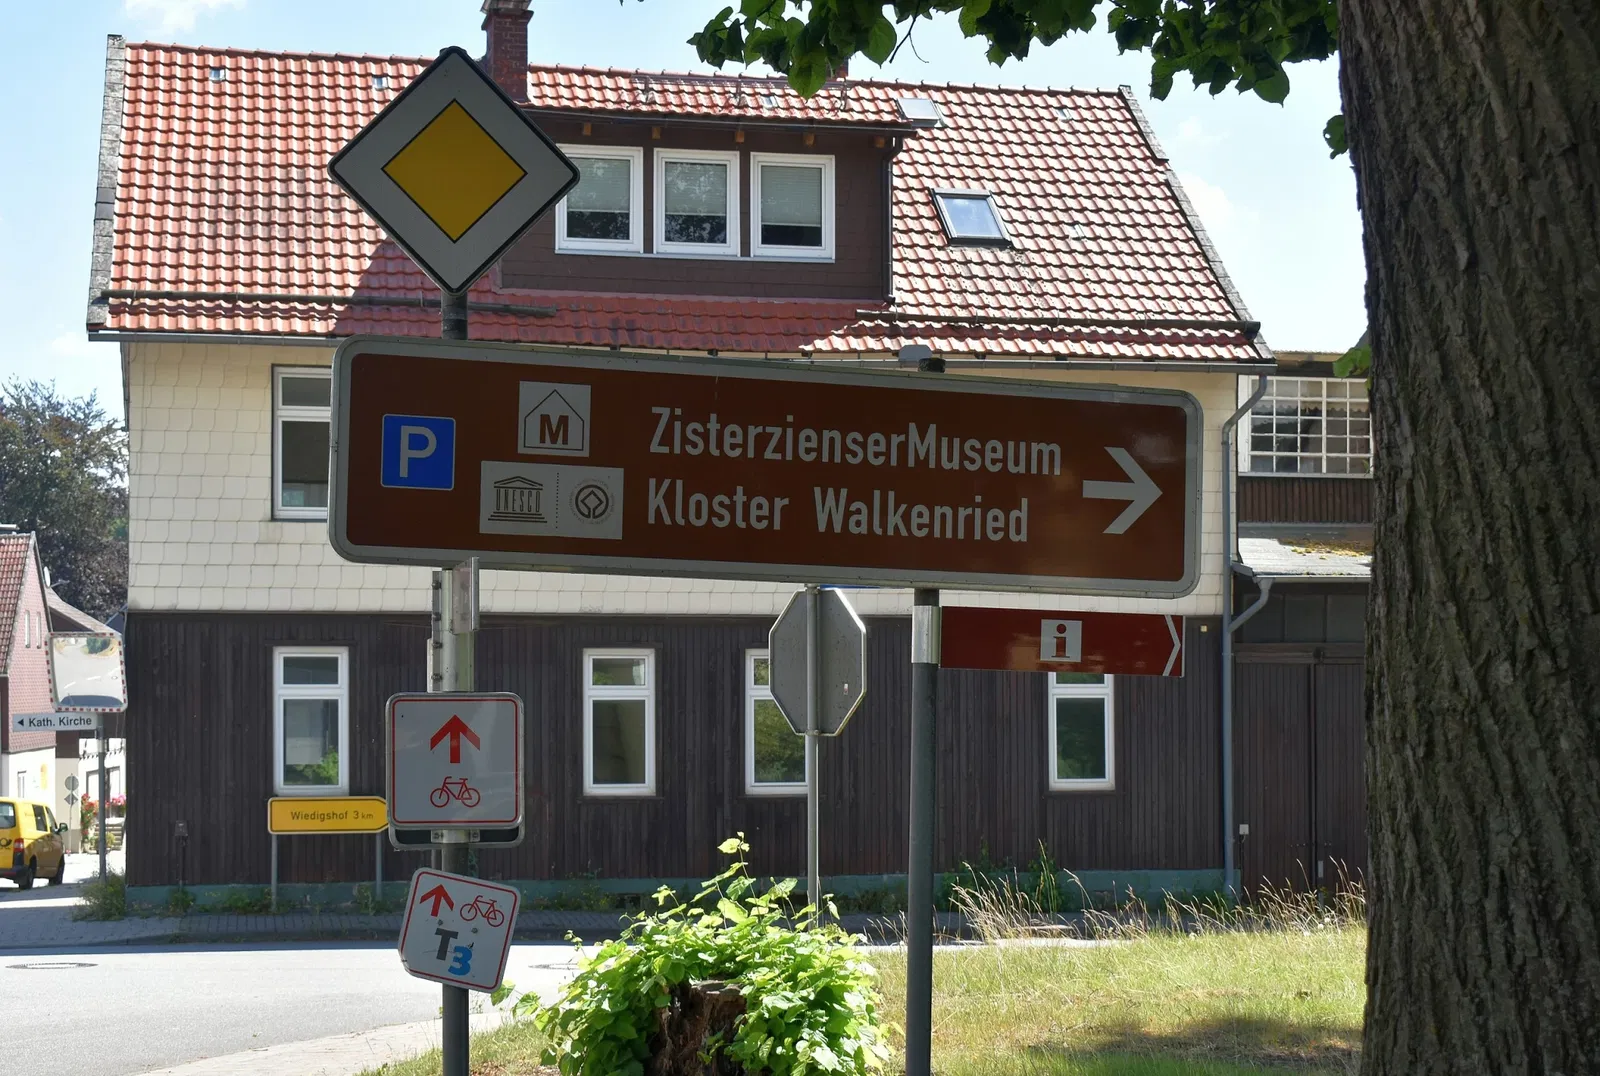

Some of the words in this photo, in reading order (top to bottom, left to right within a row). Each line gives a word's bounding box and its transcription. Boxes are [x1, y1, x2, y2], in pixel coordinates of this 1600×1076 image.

[539, 414, 569, 446] M
[649, 406, 1062, 476] ZisterzienserMuseum
[399, 425, 437, 478] P
[496, 489, 540, 512] UNESCO
[648, 477, 790, 531] Kloster
[814, 486, 1028, 543] Walkenried
[28, 717, 56, 728] Kath.
[58, 715, 92, 727] Kirche
[290, 810, 348, 822] Wiedigshof
[353, 810, 360, 820] 3
